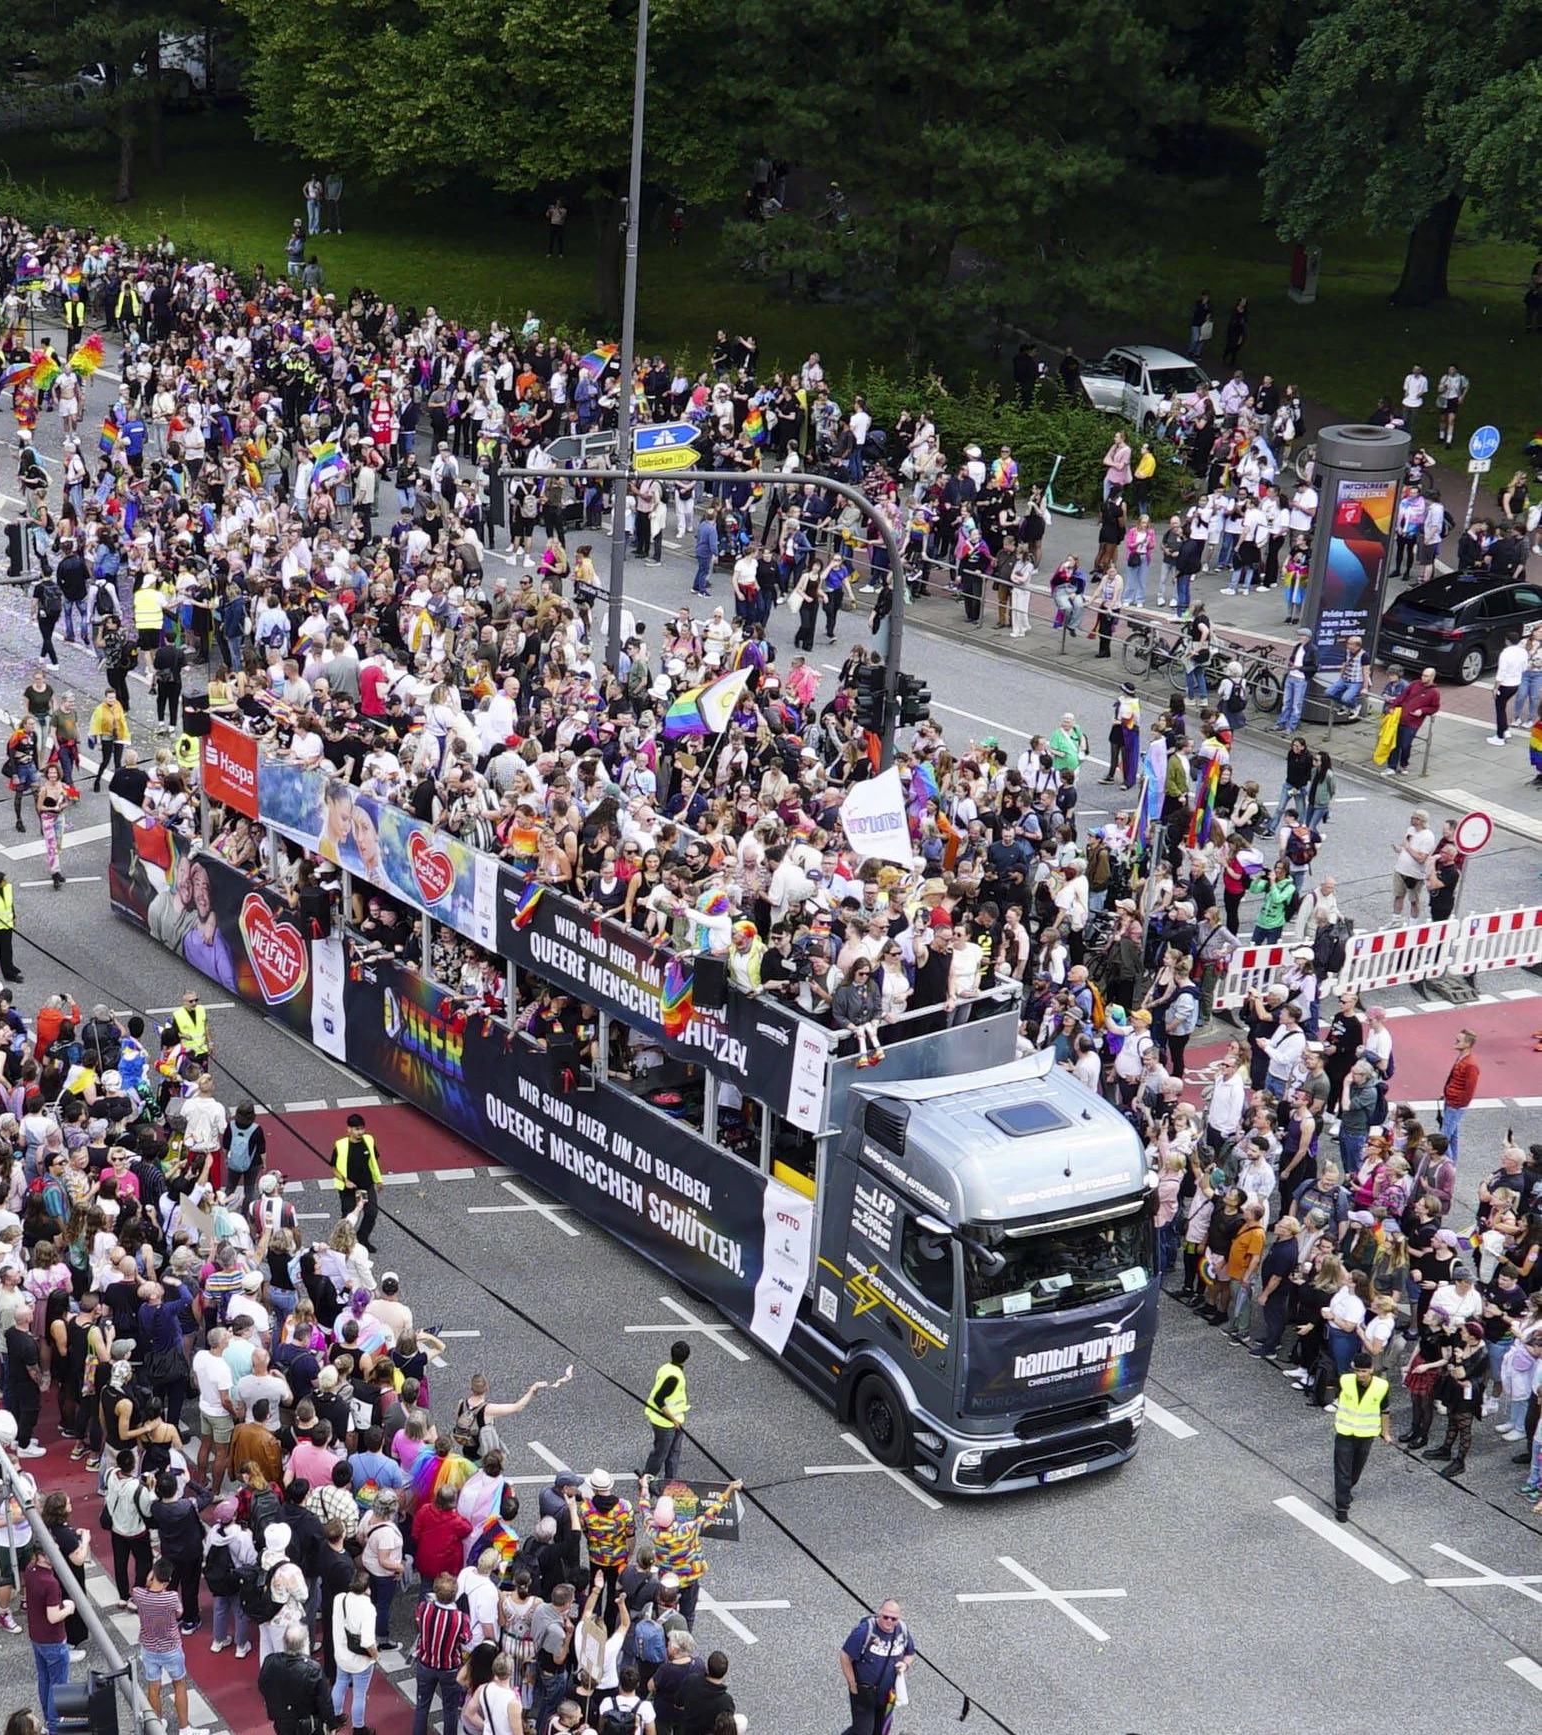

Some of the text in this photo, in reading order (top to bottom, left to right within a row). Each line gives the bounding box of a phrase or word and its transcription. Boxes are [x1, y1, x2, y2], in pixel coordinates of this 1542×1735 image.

[1322, 610, 1344, 618] Pride
[220, 751, 254, 785] Haspa
[415, 856, 446, 890] Vielfalt
[249, 927, 300, 980] VIELFALT
[555, 914, 660, 988] WIR SIND HIER, UM
[530, 932, 586, 982] QUEERE
[589, 966, 664, 1024] MENSCHE
[384, 987, 464, 1082] QUEER
[803, 1040, 821, 1054] OTTO
[518, 1076, 712, 1210] WIR SIND HIER, UM ZU BLEIBEN.
[486, 1093, 745, 1278] QUEERE MENSCHEN SCHÜTZEN.
[864, 1145, 907, 1182] NORD-OSTSEE
[906, 1177, 951, 1212] AUTOMOBILE
[1008, 1172, 1131, 1206] NORD-OSTSEE AUTOMOBILE
[871, 1188, 896, 1217] LFP
[777, 1212, 800, 1231] OTTO
[862, 1211, 891, 1241] 500km
[847, 1252, 949, 1345] NORD-OSTSEE AUTOMOBILE
[914, 1334, 926, 1349] JP
[1014, 1330, 1137, 1379] hamburgpride
[1028, 1370, 1078, 1387] CHRISTOPHER
[1080, 1363, 1106, 1378] STREET
